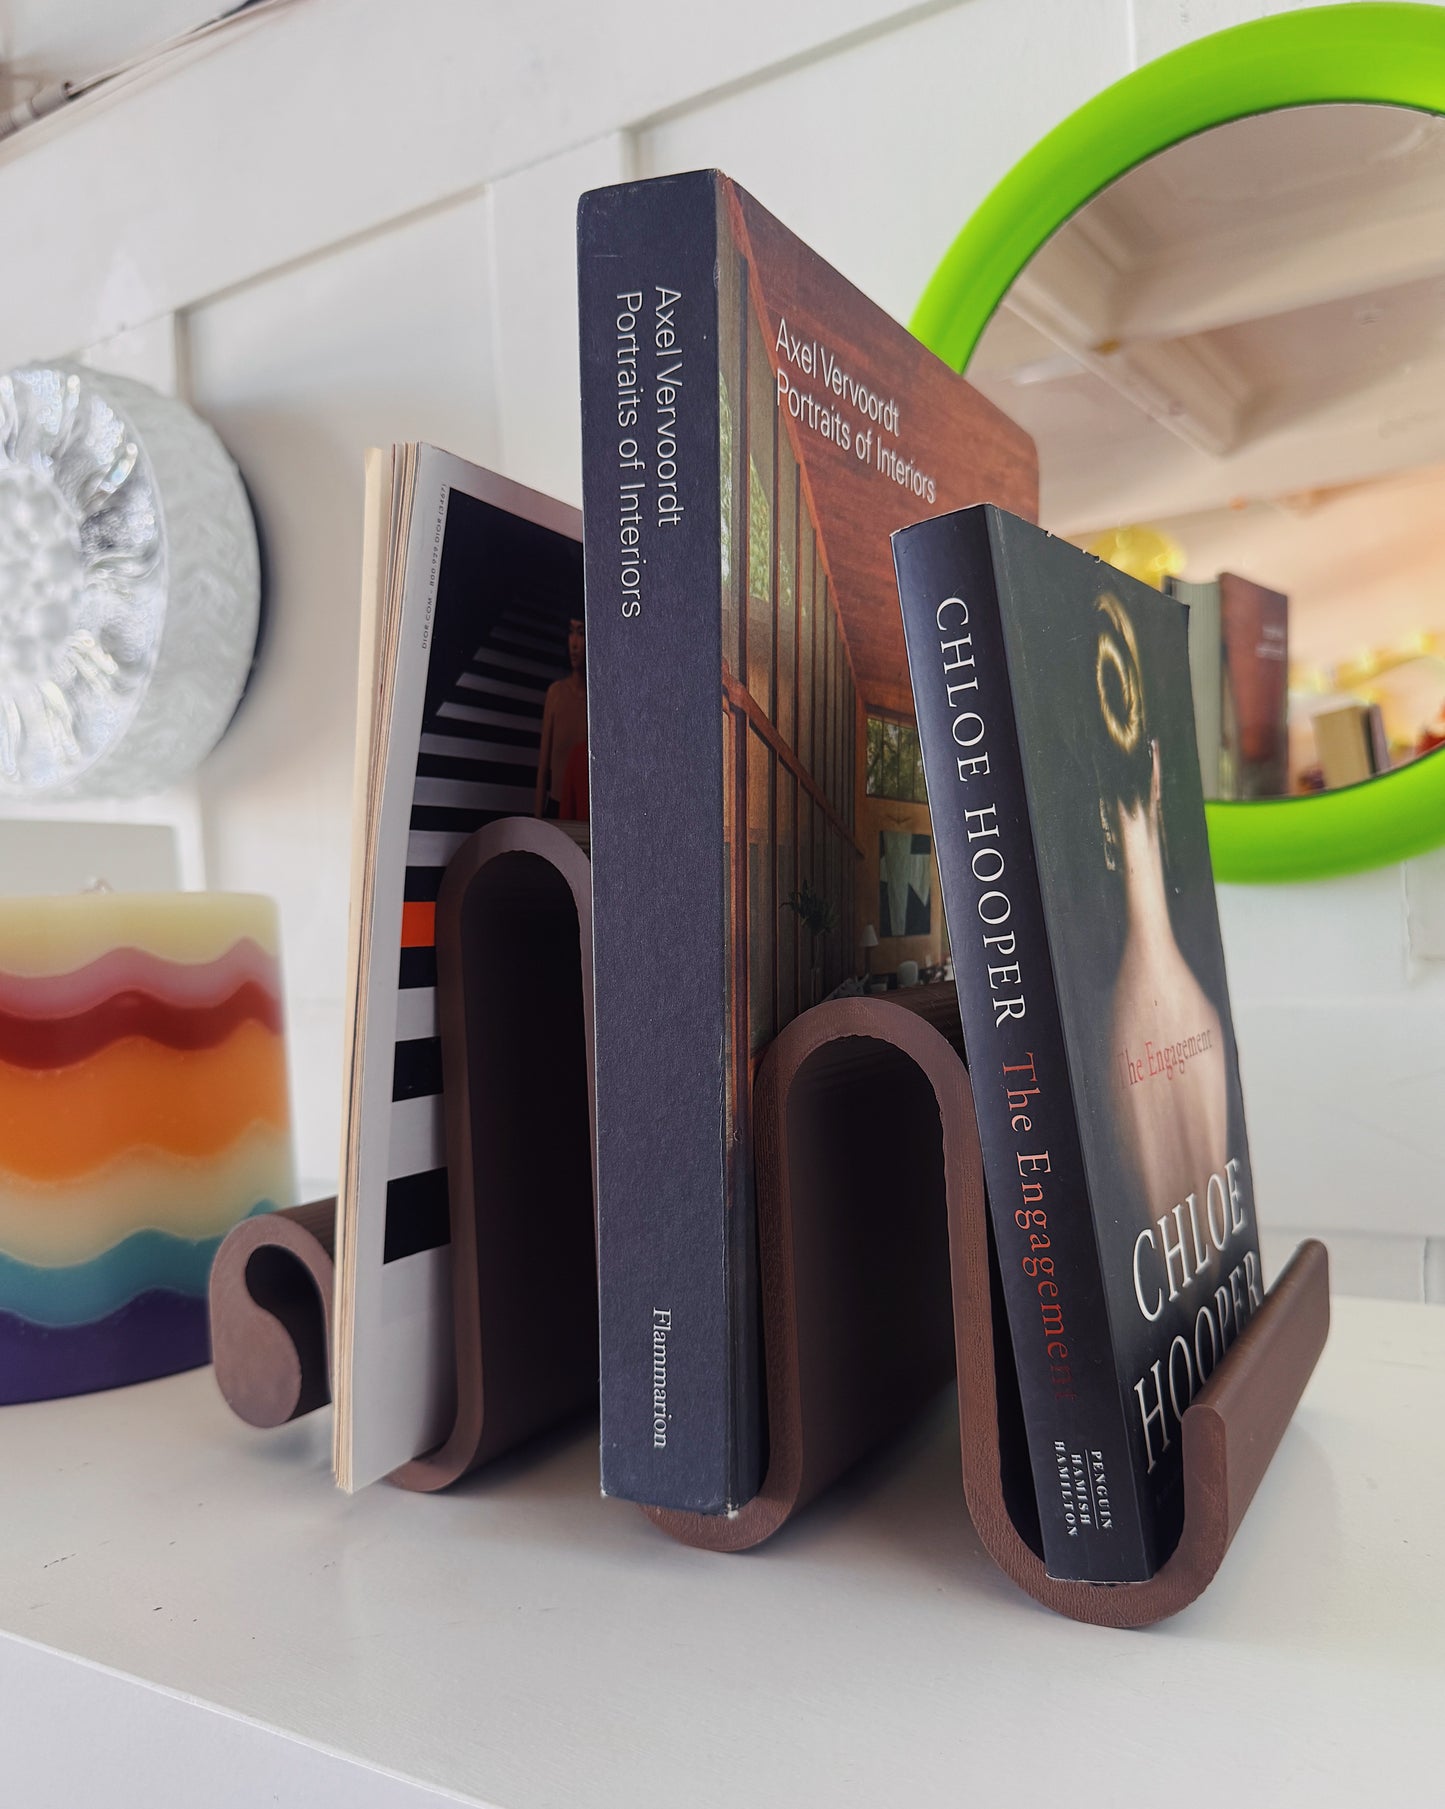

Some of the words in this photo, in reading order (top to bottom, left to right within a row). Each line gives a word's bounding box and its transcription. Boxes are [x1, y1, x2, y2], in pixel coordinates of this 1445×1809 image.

[616, 291, 644, 428] Portraits
[655, 286, 682, 356] Axel
[775, 318, 817, 378] Axel
[821, 348, 900, 437] Vervoordt
[619, 438, 645, 470] of
[656, 362, 684, 527] Vervoordt
[776, 368, 851, 451] Portraits
[856, 429, 873, 465] of
[877, 437, 936, 503] Interiors
[620, 483, 646, 618] Interiors
[421, 597, 433, 649] DIOR.COM
[935, 597, 990, 783] CHLOE
[963, 803, 1027, 1028] HOOPER
[1003, 1052, 1041, 1132] The
[1117, 1047, 1144, 1090] The
[1145, 1029, 1213, 1080] Engagement
[1015, 1150, 1078, 1401] Engagement
[1133, 1158, 1248, 1322] CHLOE
[653, 1307, 672, 1449] Flammarion
[1134, 1251, 1264, 1474] HOOPER
[1054, 1441, 1078, 1536] HAMILTON
[1071, 1454, 1092, 1525] HAMISH
[1091, 1451, 1113, 1528] PENGUIN
